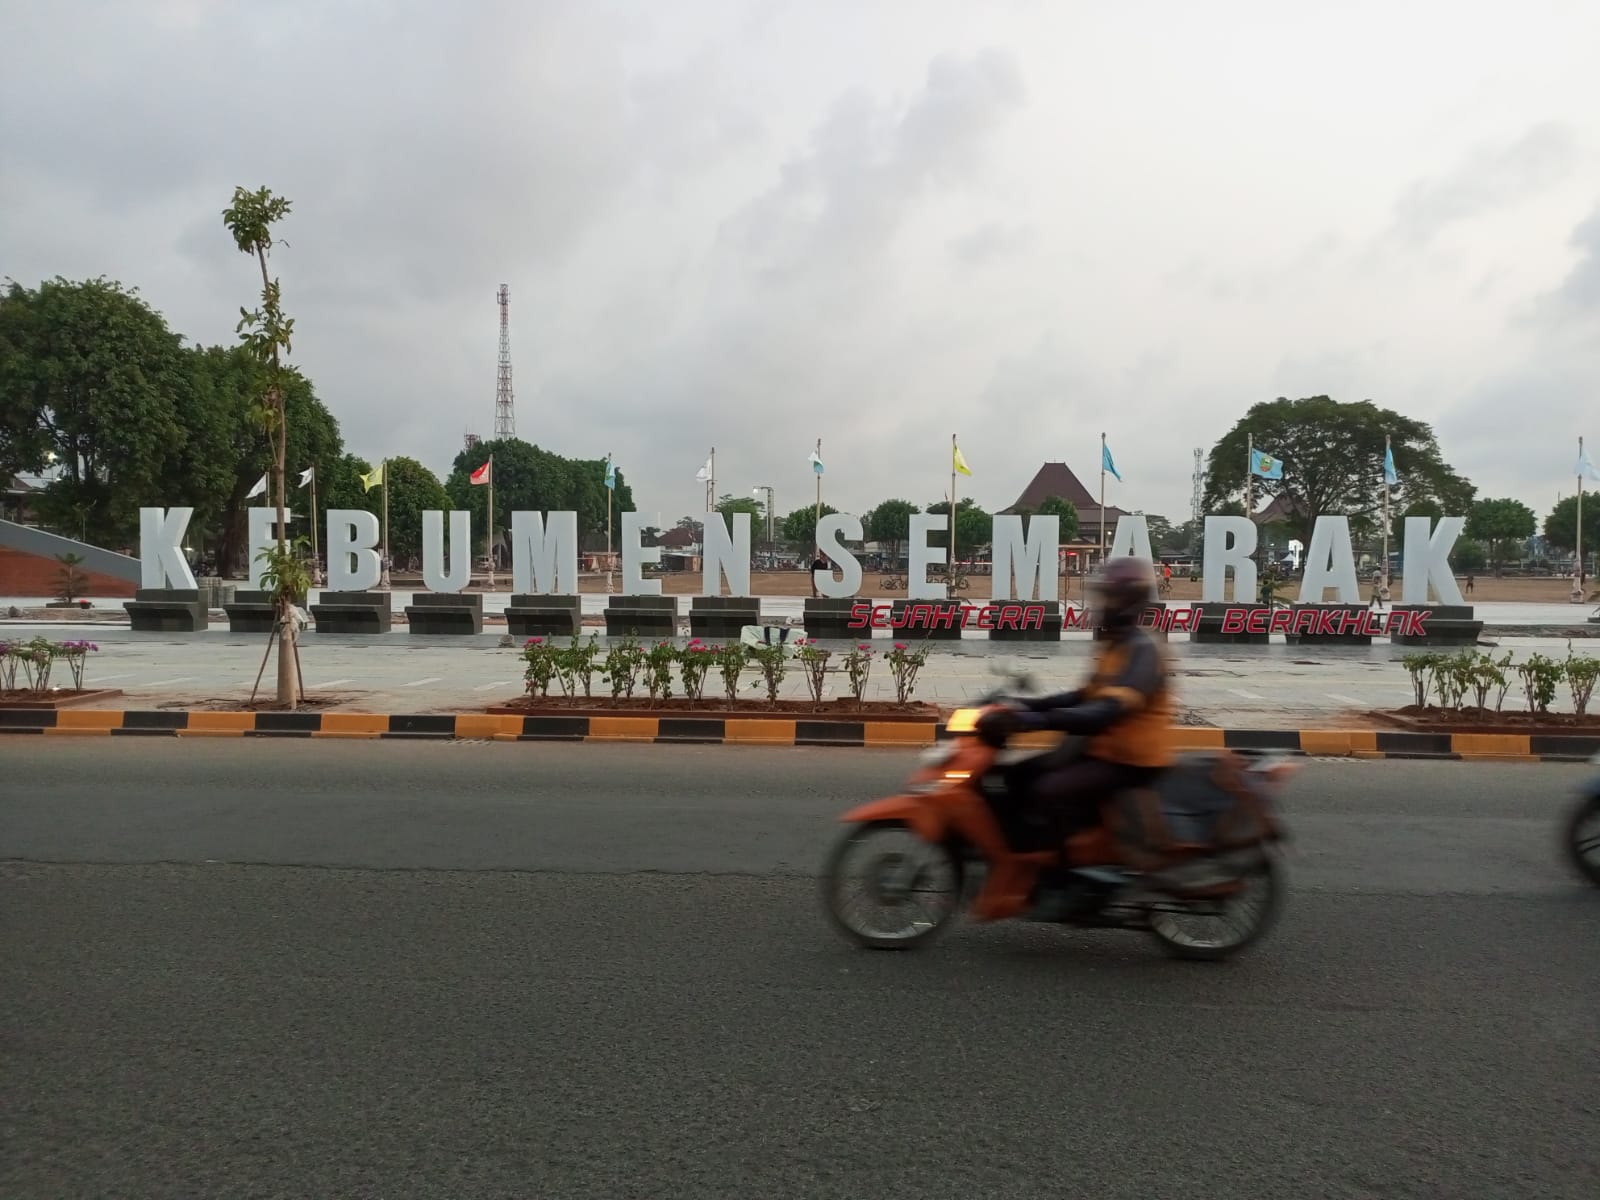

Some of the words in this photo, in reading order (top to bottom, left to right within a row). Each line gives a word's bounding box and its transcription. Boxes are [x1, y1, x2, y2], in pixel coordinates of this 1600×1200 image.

[139, 507, 752, 598] KEBUMEN
[848, 603, 1046, 630] SEJAHTERA
[1063, 606, 1203, 633] MDIRI
[1221, 608, 1433, 636] BERAKHLAK
